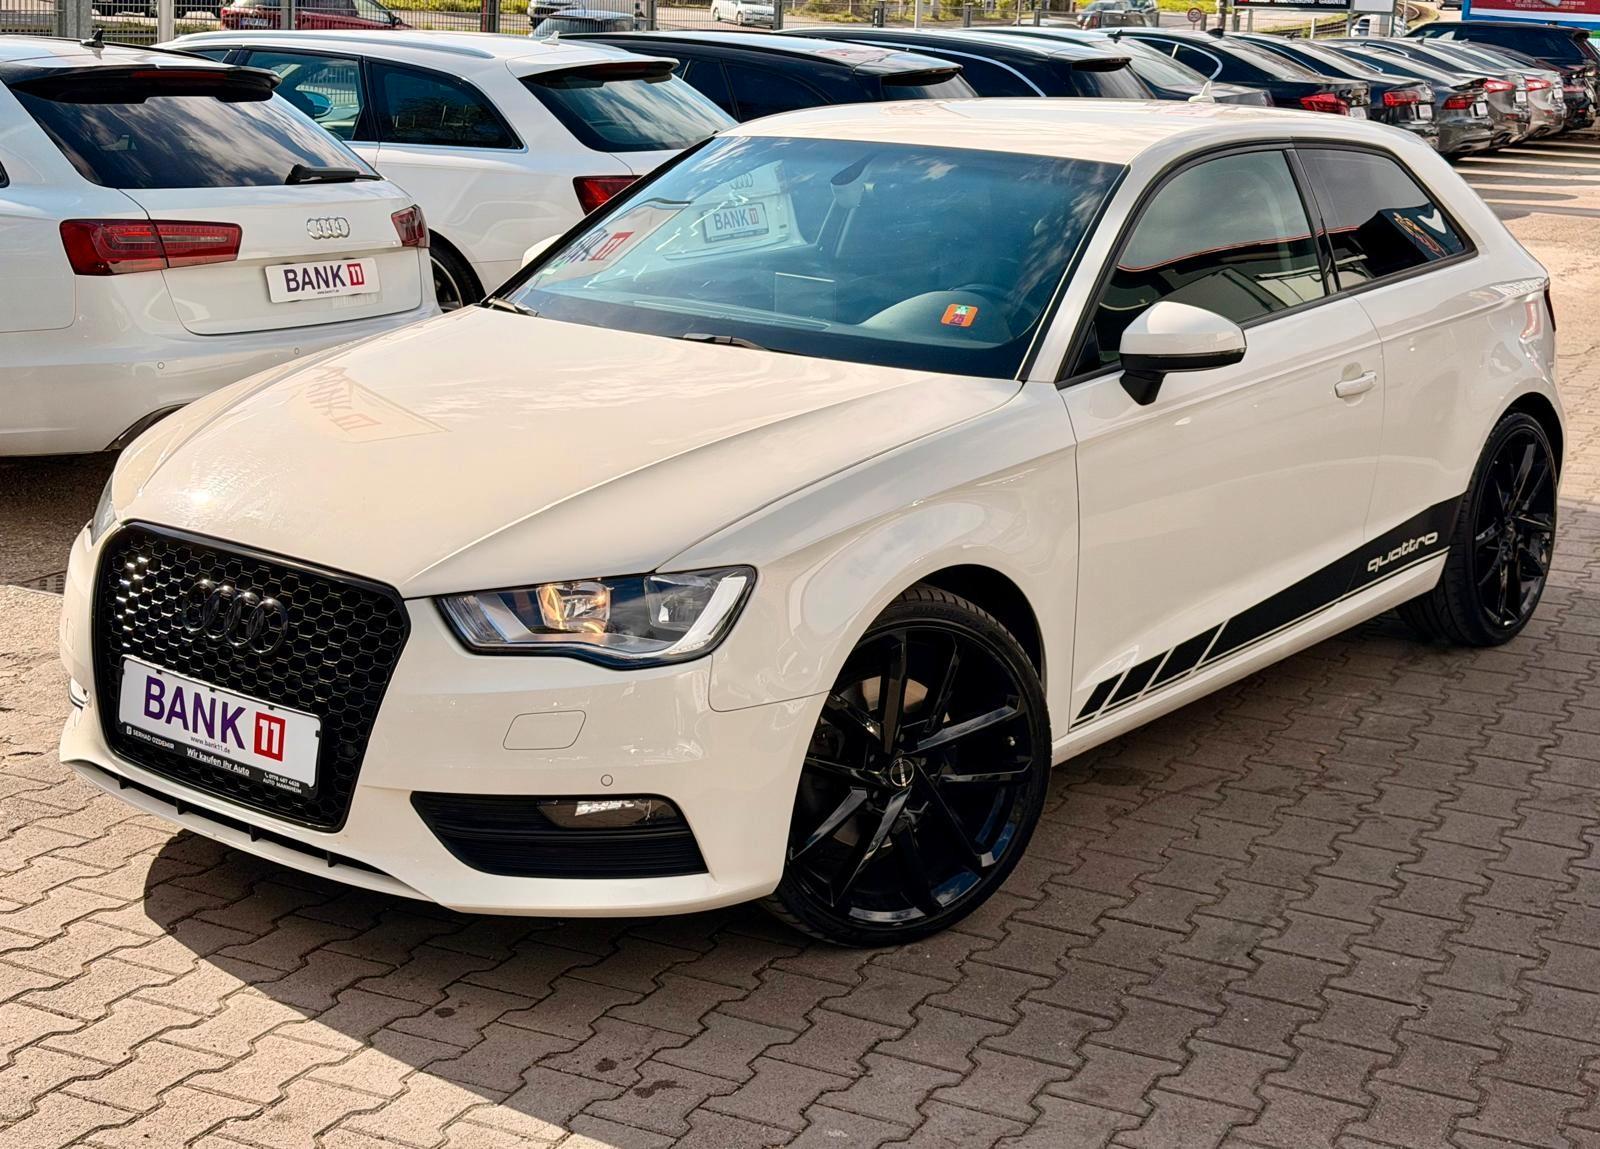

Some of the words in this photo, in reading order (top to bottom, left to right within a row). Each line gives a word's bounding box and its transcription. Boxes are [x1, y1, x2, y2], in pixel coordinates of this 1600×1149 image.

[713, 209, 750, 230] BANK
[283, 264, 346, 292] BANK
[348, 265, 364, 285] 11
[1367, 531, 1438, 573] quattro
[143, 674, 247, 750] BANK
[257, 715, 282, 758] 11
[190, 736, 231, 754] www.bank11.de
[186, 746, 198, 758] Wir
[199, 751, 222, 767] kaufen
[222, 759, 233, 771] Ihr
[233, 763, 250, 776] Auto
